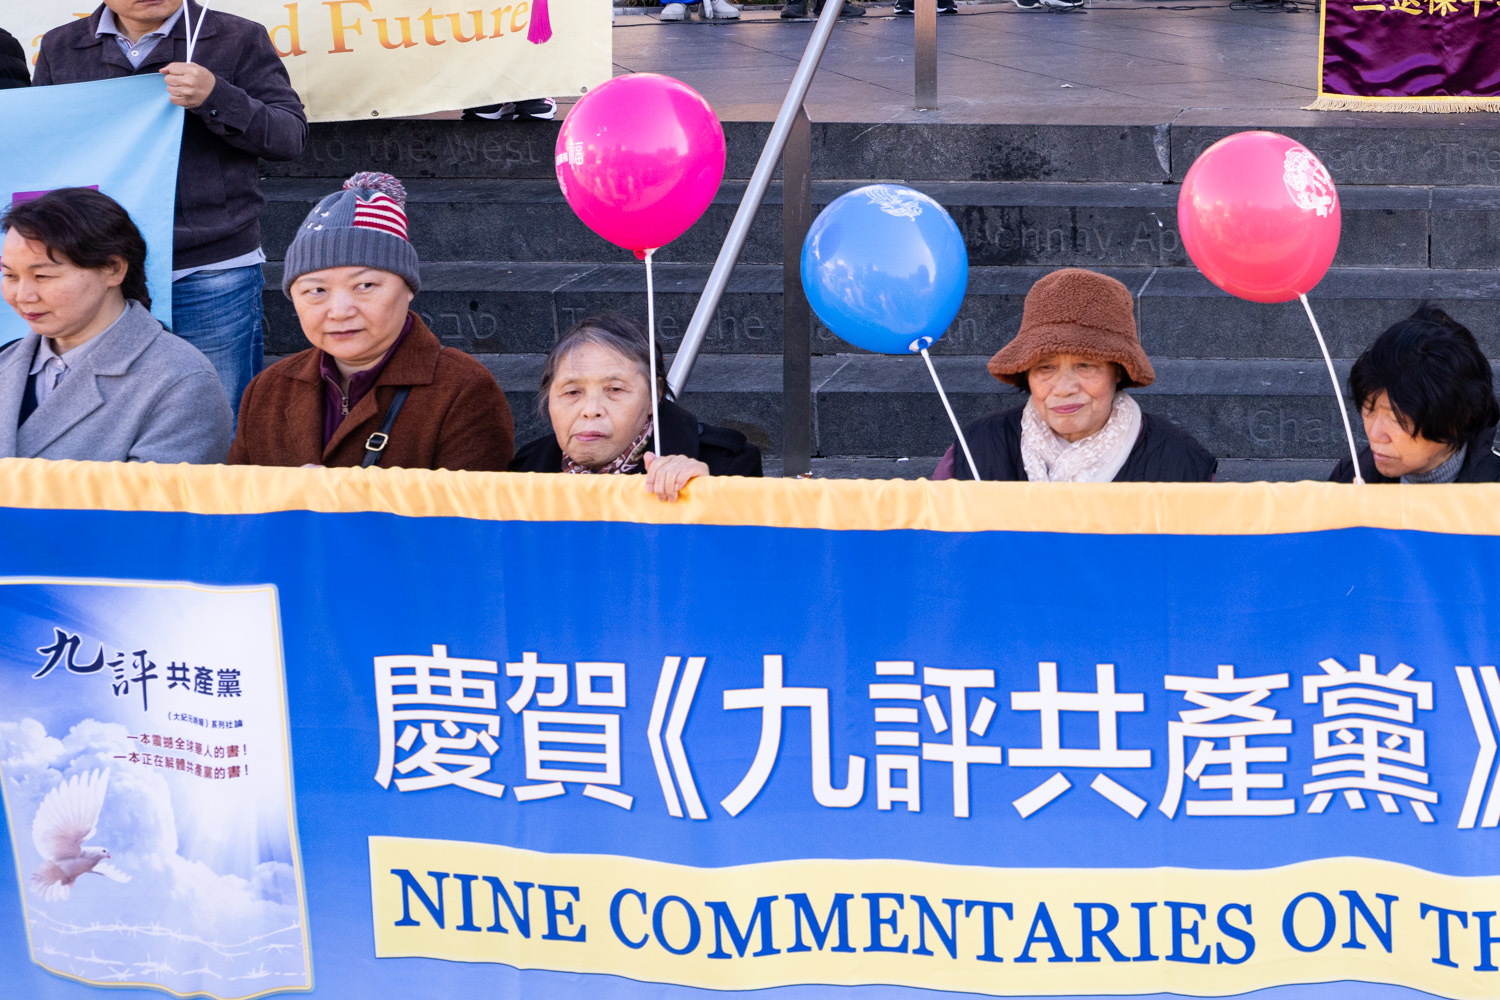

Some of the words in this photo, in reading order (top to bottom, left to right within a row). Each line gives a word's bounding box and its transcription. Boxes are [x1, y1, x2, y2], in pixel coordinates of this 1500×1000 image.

[31, 626, 159, 712] 九評
[165, 660, 243, 699] 共產黨
[390, 867, 587, 943] NINE
[608, 886, 1257, 966] COMMENTARIES
[1280, 890, 1397, 955] ON
